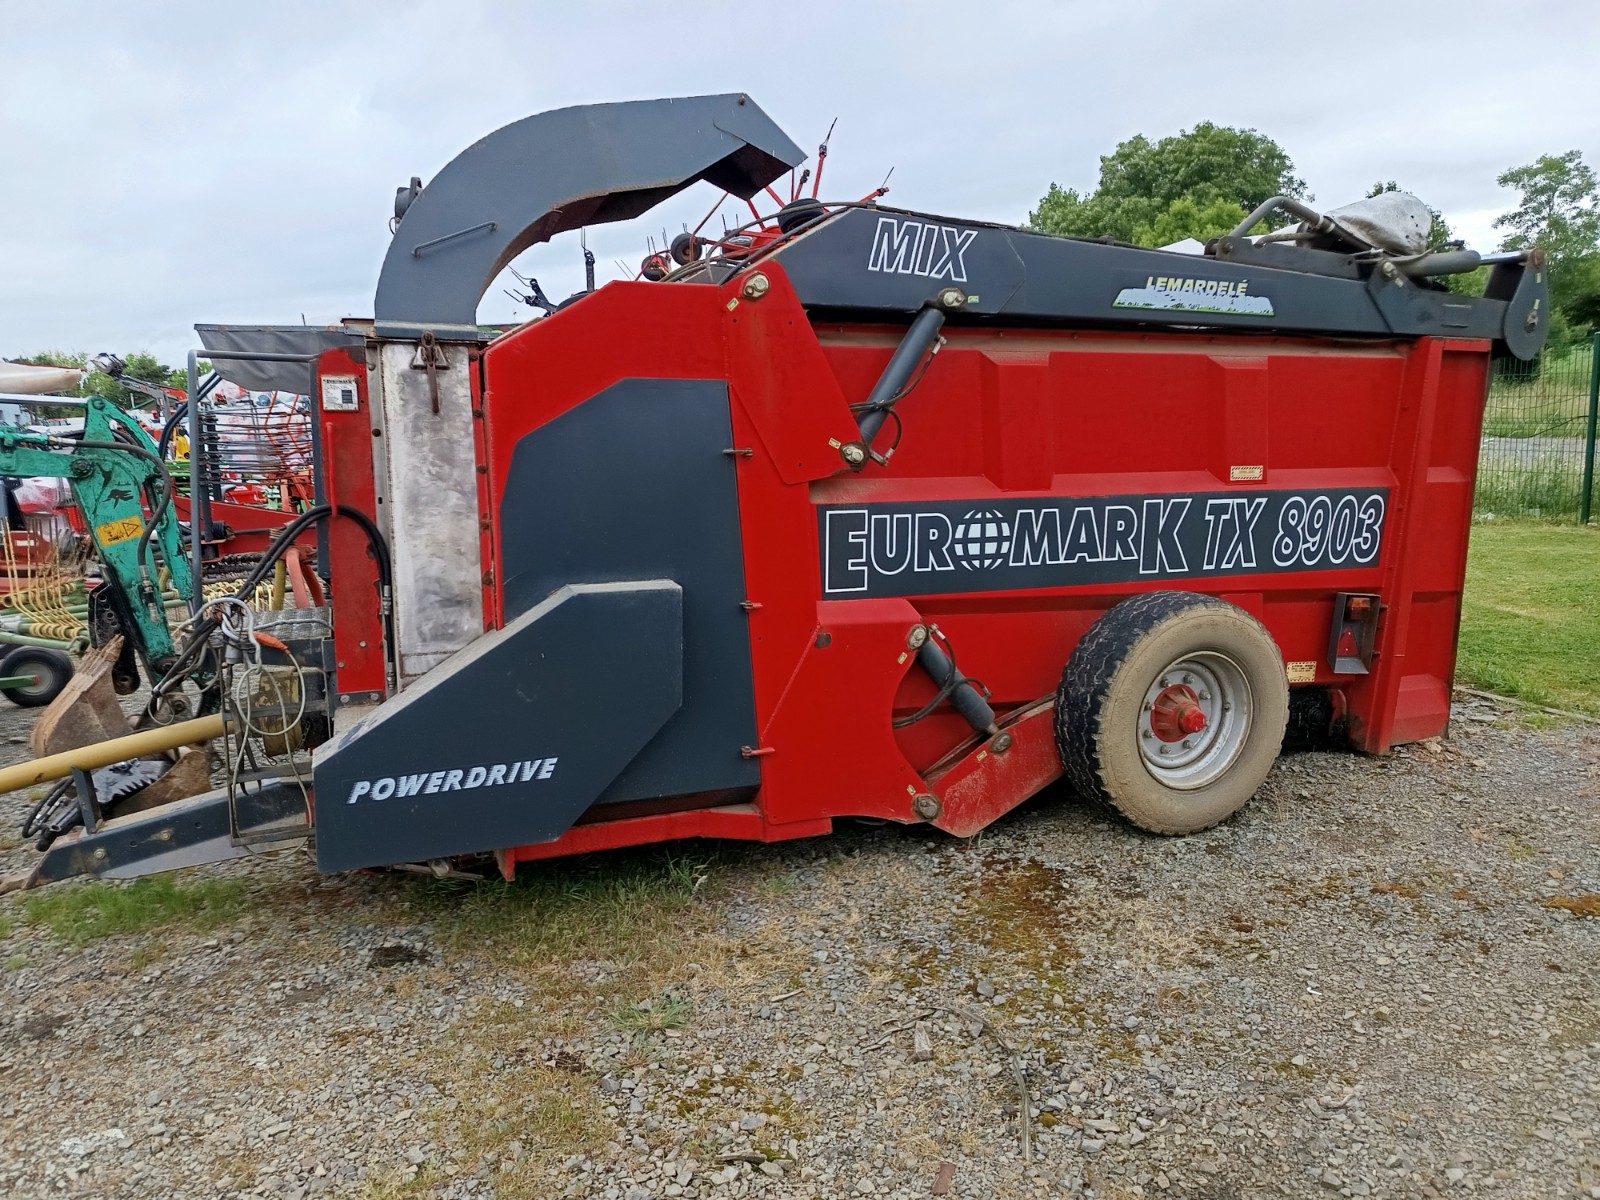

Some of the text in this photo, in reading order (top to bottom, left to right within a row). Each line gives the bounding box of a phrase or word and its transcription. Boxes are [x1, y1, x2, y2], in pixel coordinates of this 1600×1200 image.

[868, 217, 978, 283] MIX
[1146, 276, 1249, 296] LEMARDELÉ
[1203, 497, 1268, 571] TX
[1272, 494, 1385, 567] 8903
[346, 757, 559, 805] POWERDRIVE
